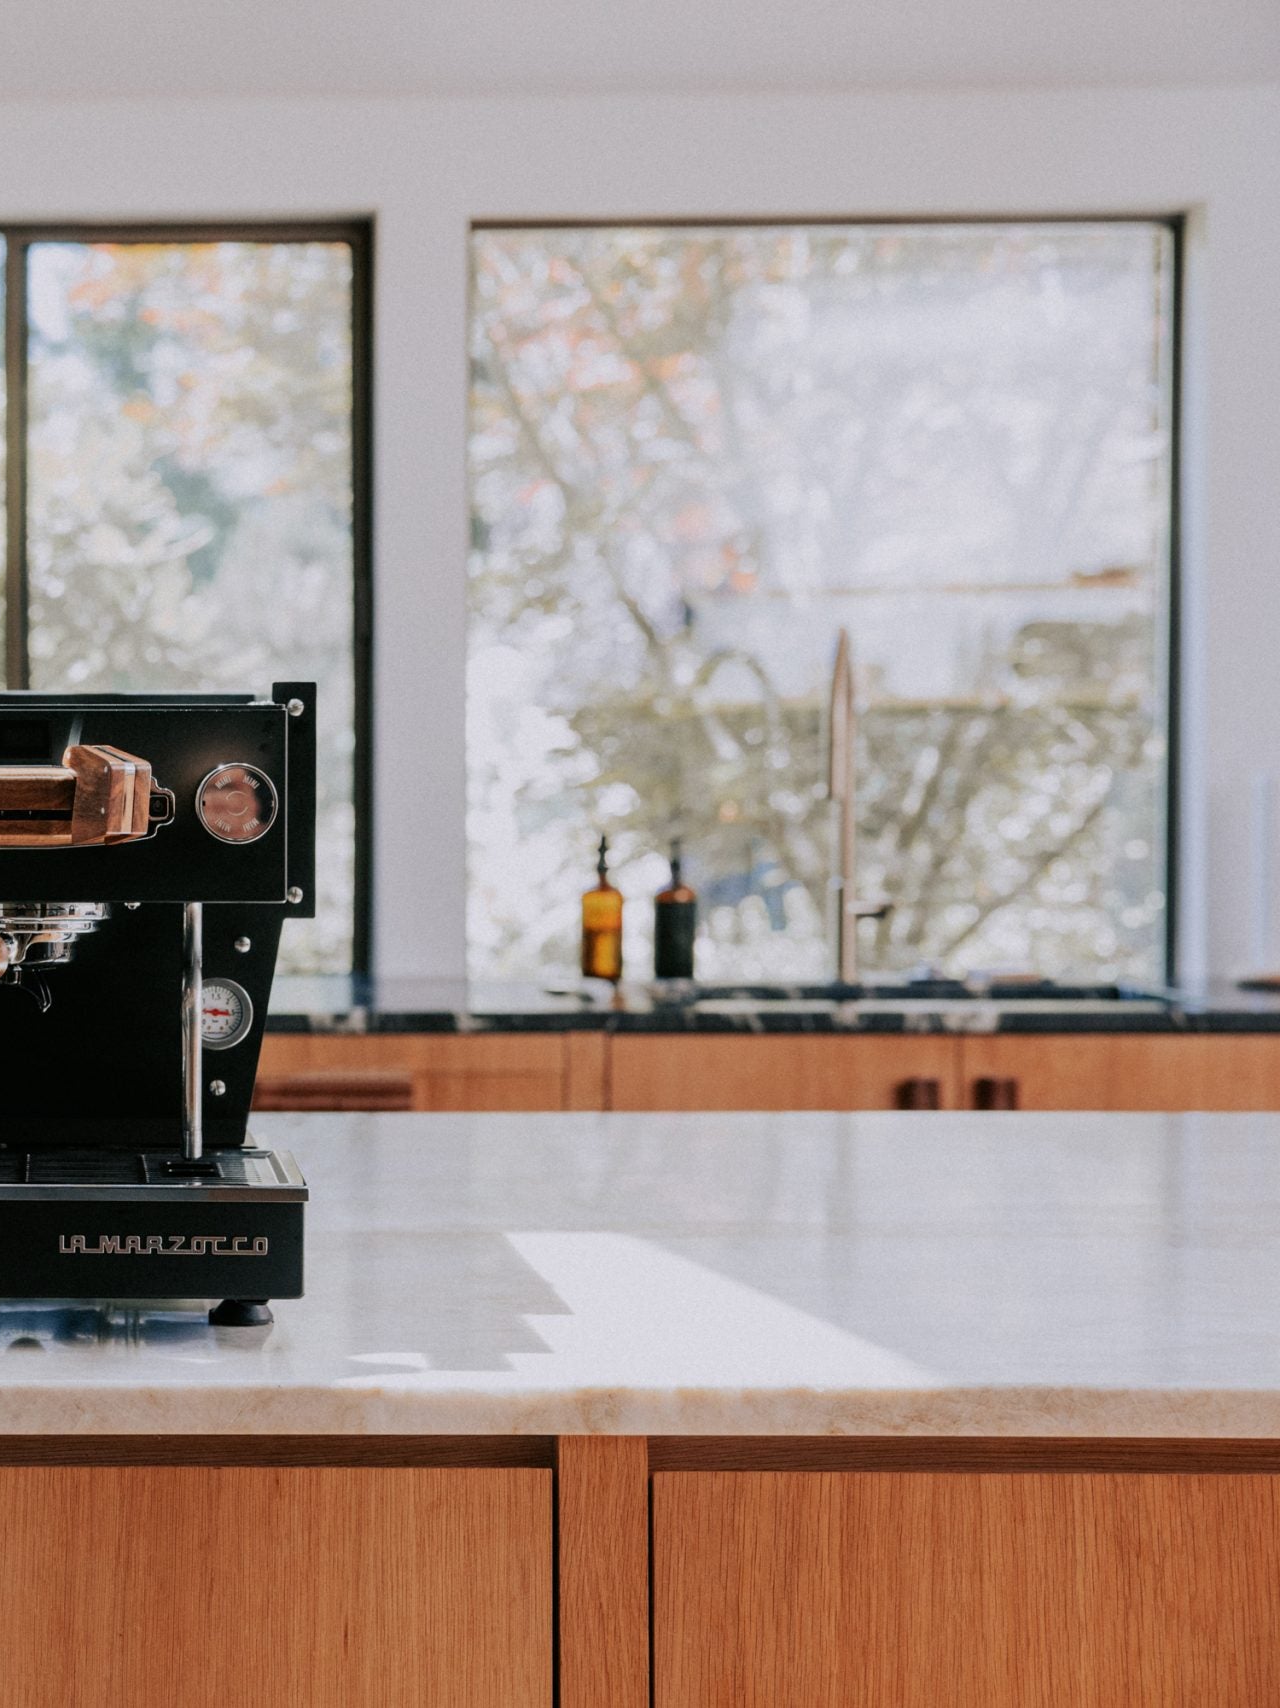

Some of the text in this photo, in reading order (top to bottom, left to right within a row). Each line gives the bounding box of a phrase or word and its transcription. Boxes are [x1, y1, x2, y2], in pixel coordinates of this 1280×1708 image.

[215, 775, 232, 789] MINI
[242, 775, 260, 789] MINI
[59, 1235, 268, 1255] LA MARZOCCO
